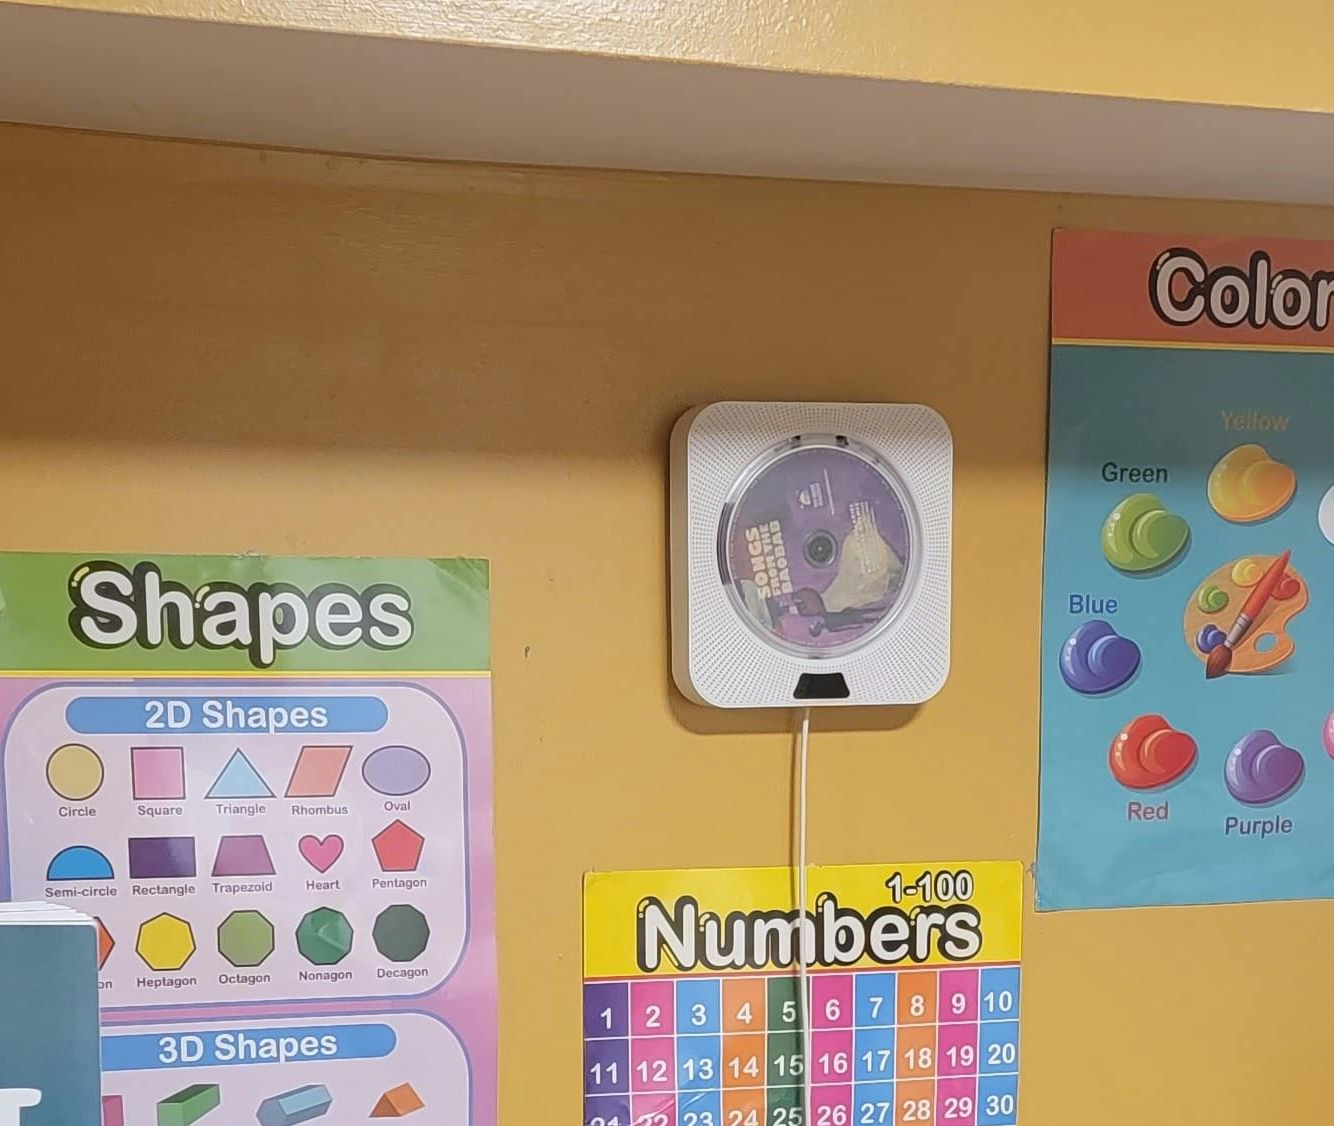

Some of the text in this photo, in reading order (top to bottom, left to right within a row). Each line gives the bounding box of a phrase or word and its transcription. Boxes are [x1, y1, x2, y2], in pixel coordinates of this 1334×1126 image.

[1220, 410, 1289, 431] Yellow
[1102, 463, 1168, 483] Green
[1069, 595, 1118, 614] Blue
[67, 560, 415, 669] Shapes
[145, 700, 328, 735] 2D Shapes
[58, 805, 97, 818] Circle
[137, 804, 183, 818] Square
[216, 803, 266, 817] Triangle
[291, 804, 348, 816] Rhombus
[384, 800, 411, 812] Oval
[1127, 802, 1169, 821] Red
[1225, 817, 1293, 839] Purple
[45, 885, 118, 897] Semi-circle
[132, 882, 196, 897] Rectangle
[212, 880, 273, 894] Trapezoid
[306, 878, 340, 891] Heart
[371, 876, 427, 891] Pentagon
[886, 869, 974, 903] 1-100
[636, 892, 982, 973] Numbers
[218, 972, 271, 986] Octagon
[298, 969, 353, 984] Nonagon
[376, 966, 429, 982] Decagon
[136, 975, 197, 990] Heptagon
[158, 1030, 338, 1064] 3D Shapes
